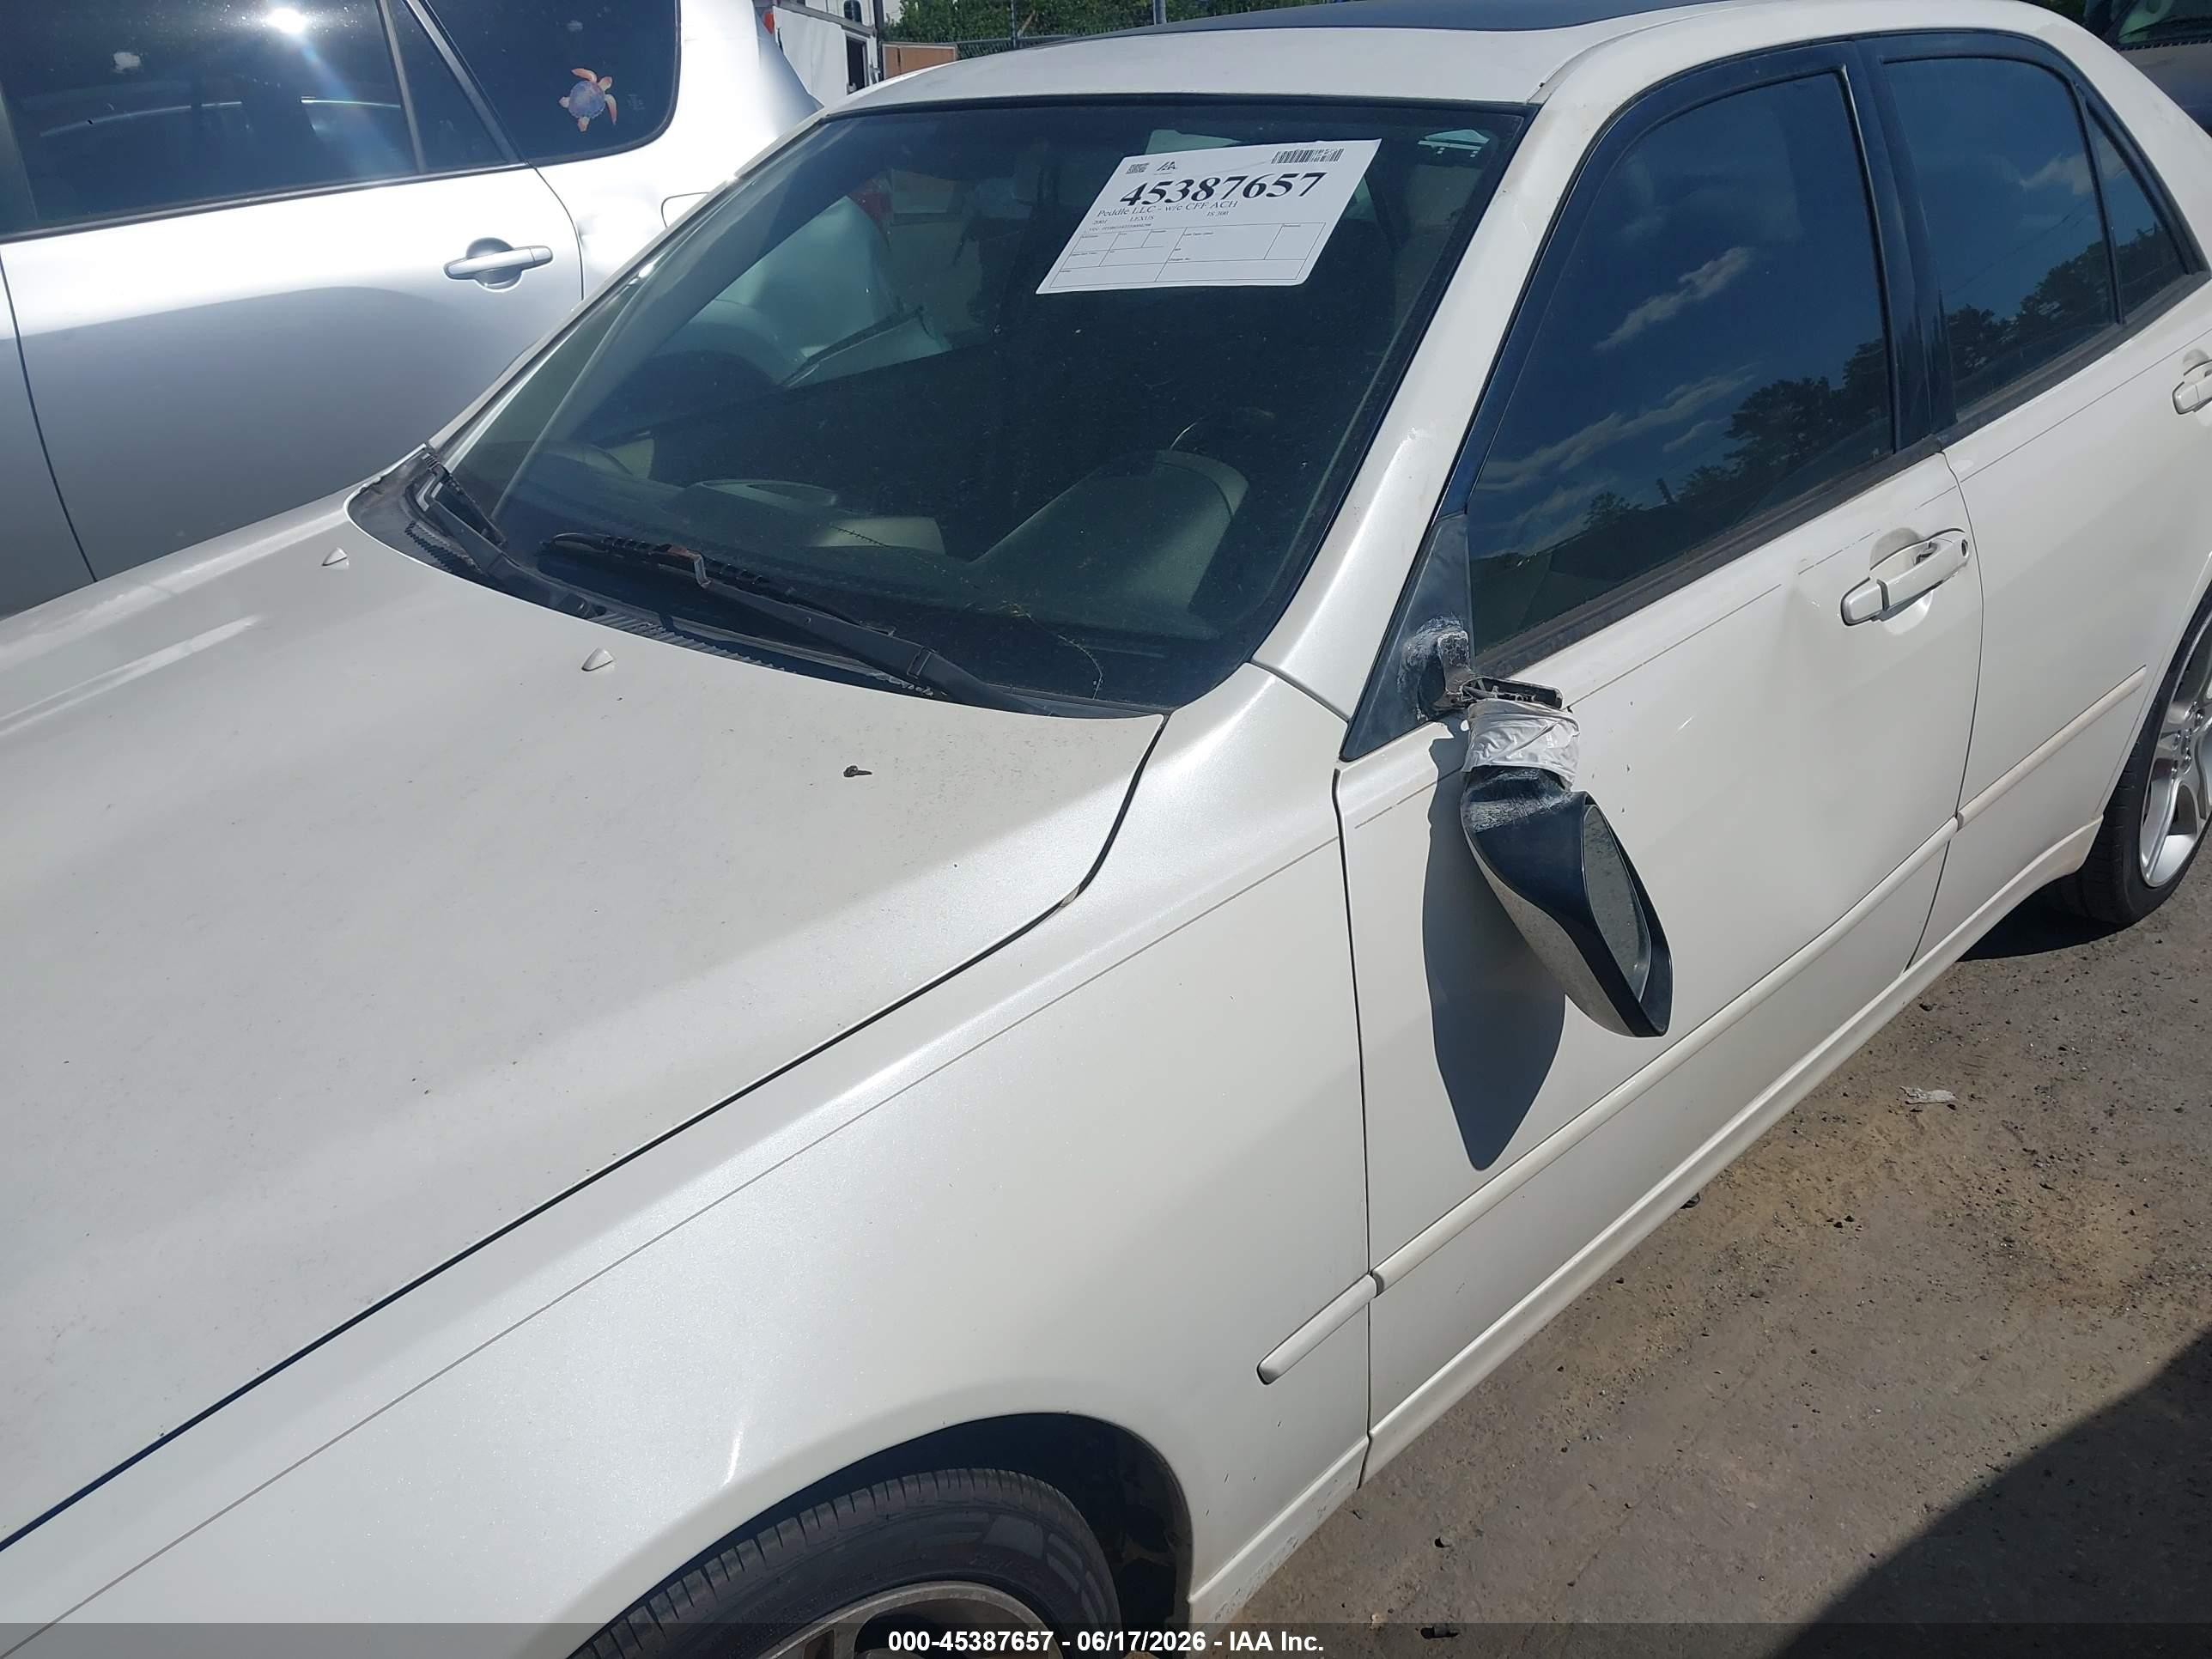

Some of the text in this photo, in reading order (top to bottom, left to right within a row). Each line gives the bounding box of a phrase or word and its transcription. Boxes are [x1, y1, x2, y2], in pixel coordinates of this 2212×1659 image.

[1120, 172, 1328, 206] 45387657
[1097, 207, 1129, 217] Peddle
[1132, 205, 1156, 214] LLC
[1210, 200, 1238, 209] ACH
